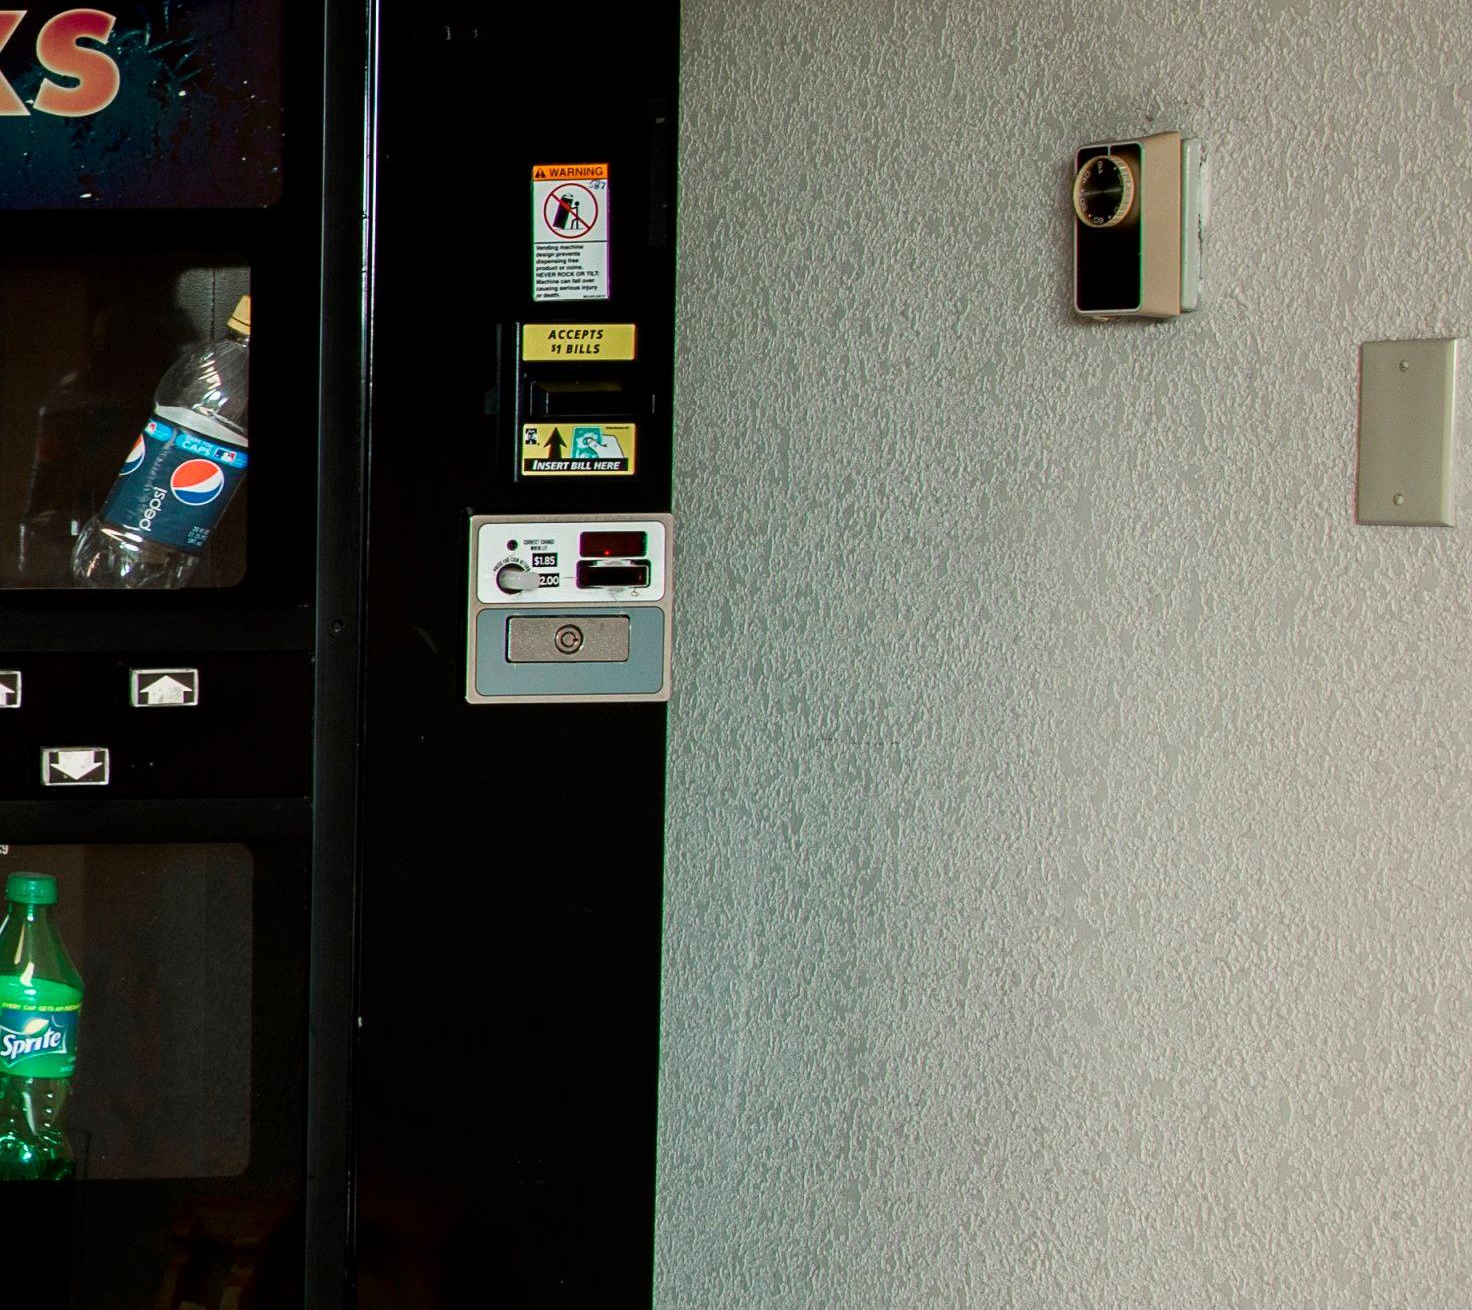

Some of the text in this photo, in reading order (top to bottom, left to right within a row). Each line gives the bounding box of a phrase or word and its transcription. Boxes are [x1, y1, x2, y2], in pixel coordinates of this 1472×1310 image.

[550, 167, 603, 177] WARNING
[548, 330, 603, 340] ACCEPTS
[551, 344, 600, 354] $1 BILLS
[571, 461, 591, 470] BILL
[594, 461, 620, 470] HERE
[139, 486, 167, 532] pepsi
[534, 556, 555, 566] $1.85
[0, 1027, 62, 1060] Sprite
